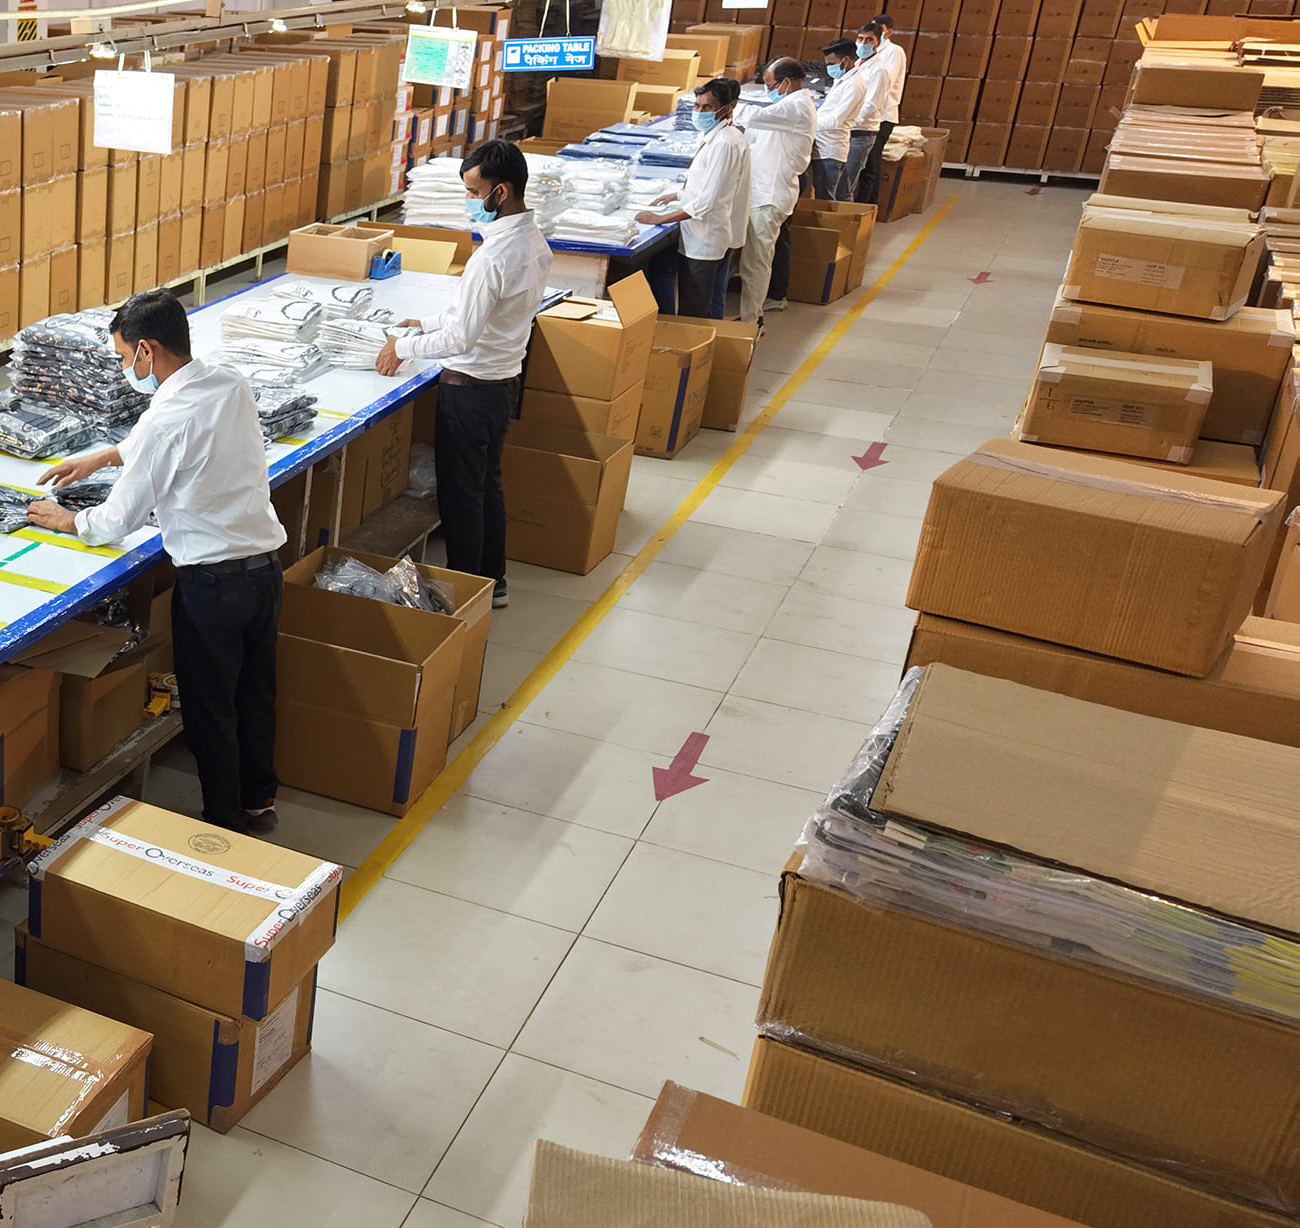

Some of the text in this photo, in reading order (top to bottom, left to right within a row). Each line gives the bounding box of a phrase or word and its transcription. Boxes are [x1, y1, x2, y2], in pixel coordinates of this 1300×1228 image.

[522, 42, 590, 53] PACKING TABLE
[523, 53, 587, 66] पैकिंग मेज
[100, 829, 145, 852] Super
[144, 847, 215, 878] Overseas
[226, 874, 270, 894] Super
[254, 918, 285, 949] Super
[278, 883, 323, 922] Overseas
